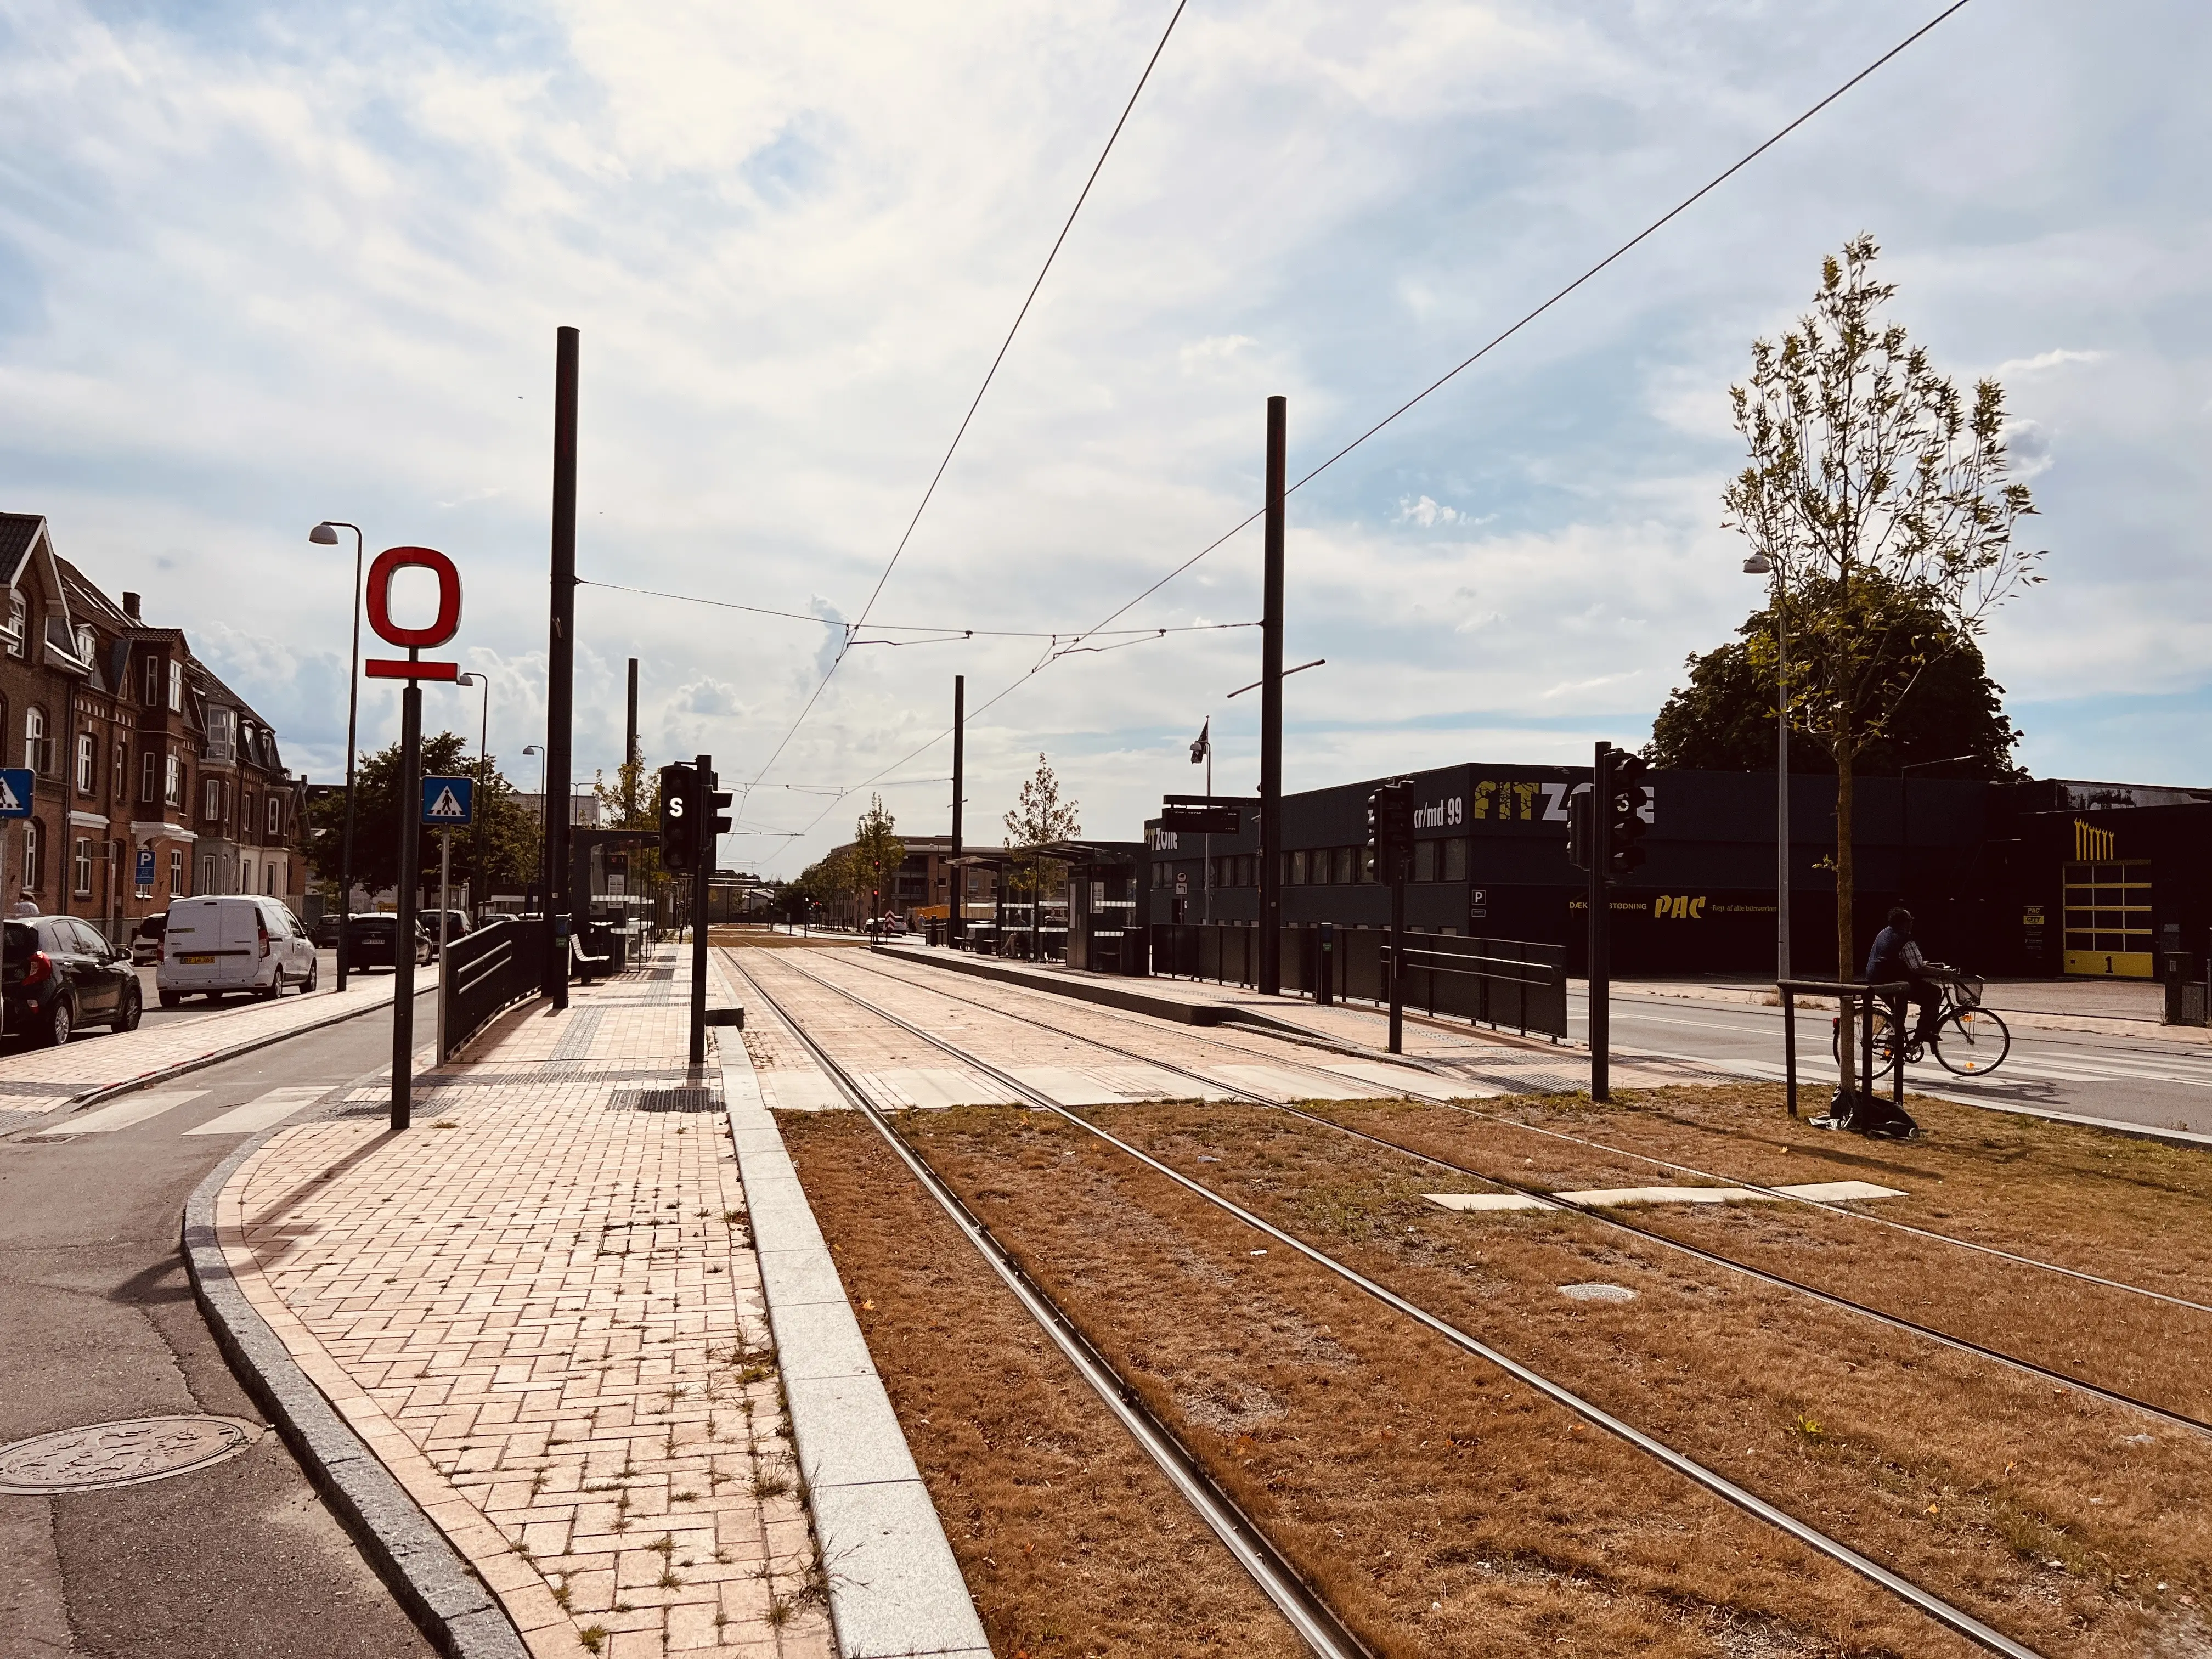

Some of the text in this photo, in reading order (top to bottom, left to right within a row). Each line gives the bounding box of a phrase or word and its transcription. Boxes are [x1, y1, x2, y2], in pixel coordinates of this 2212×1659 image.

[670, 797, 683, 817] S
[1447, 797, 1462, 826] 99
[1475, 781, 1655, 823] FITZE
[140, 853, 151, 866] P
[1475, 891, 1483, 903] P
[1654, 895, 1706, 919] PAC
[2105, 956, 2114, 973] 1
